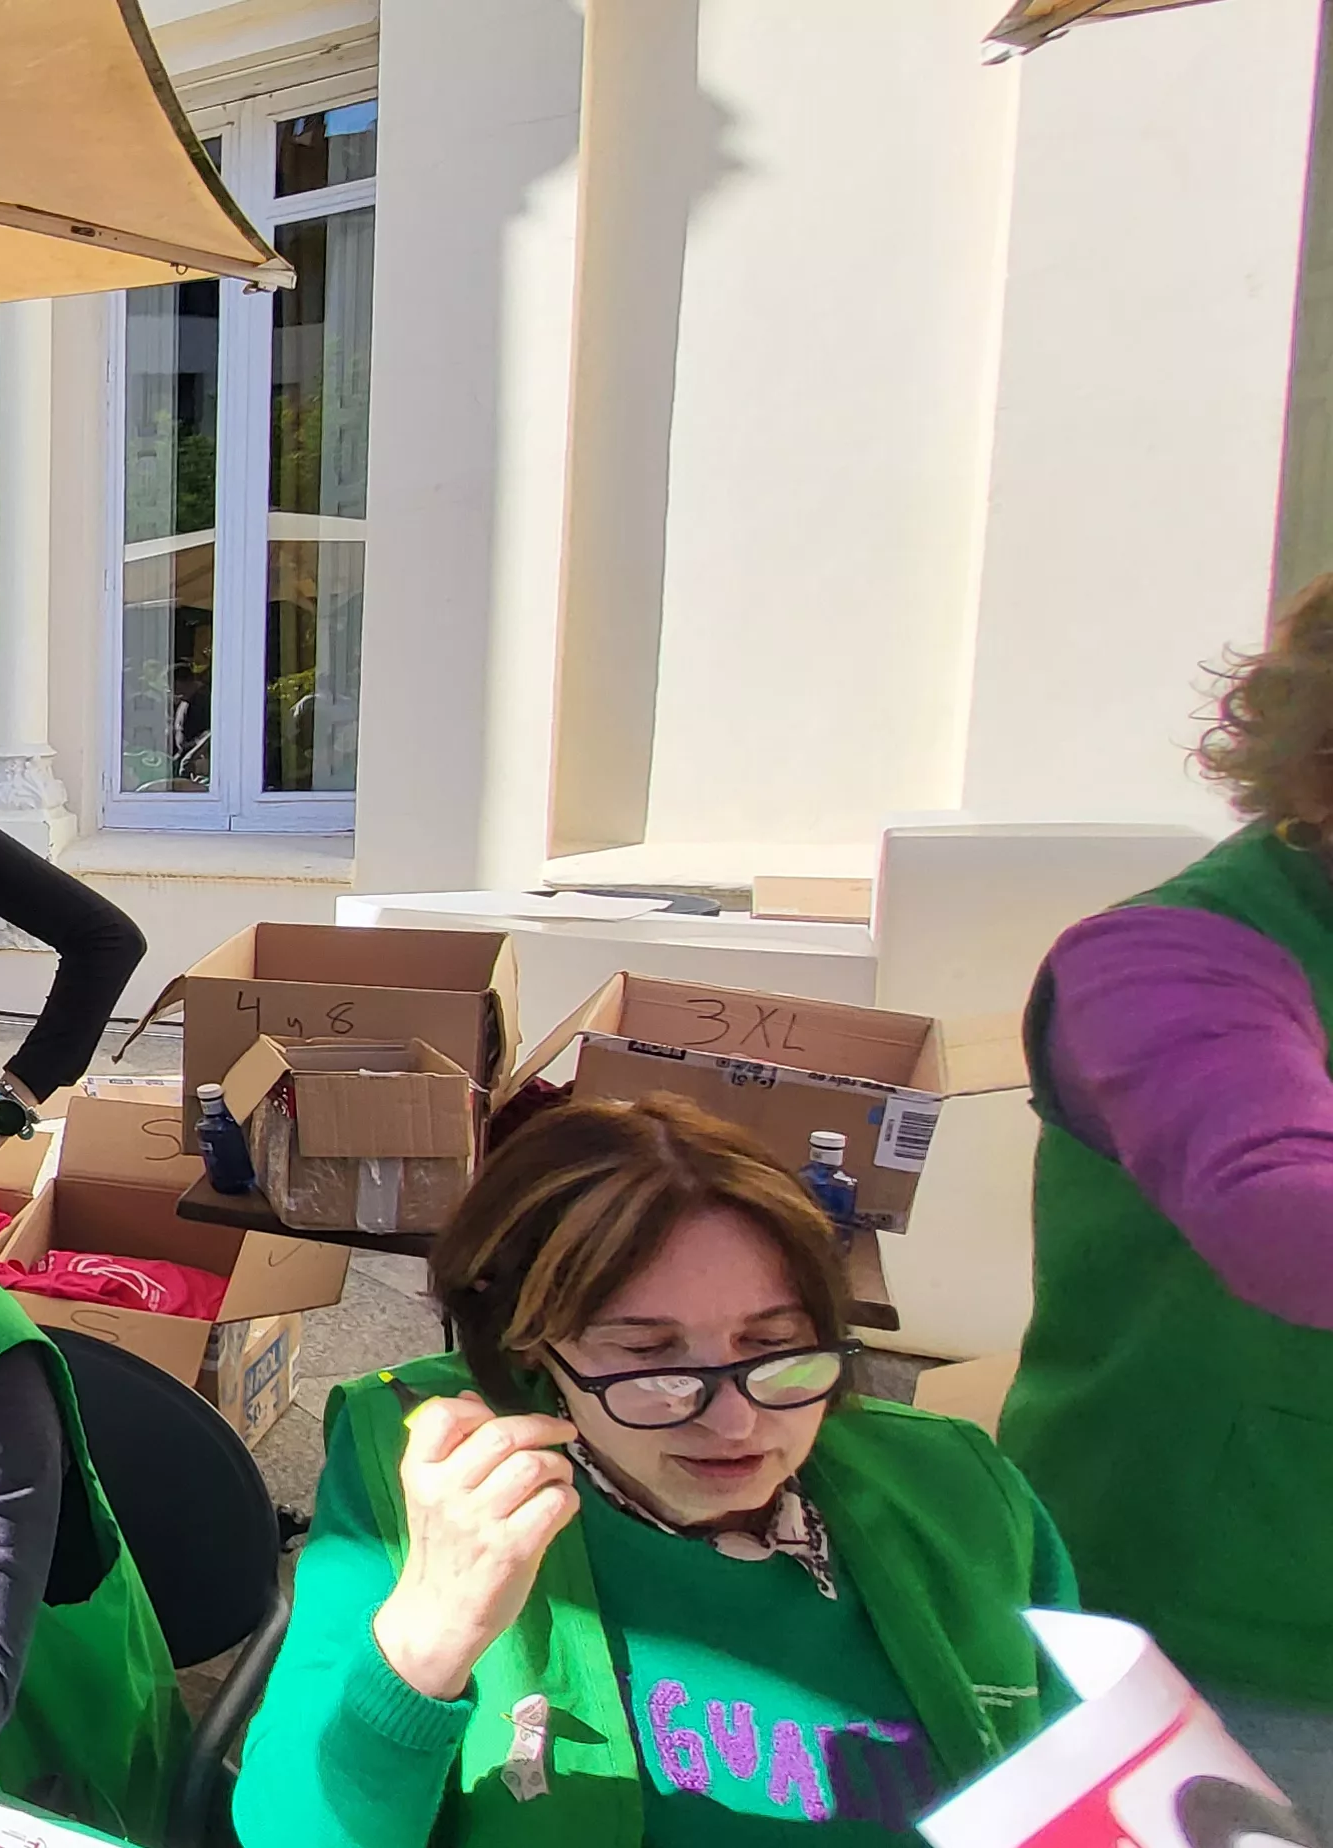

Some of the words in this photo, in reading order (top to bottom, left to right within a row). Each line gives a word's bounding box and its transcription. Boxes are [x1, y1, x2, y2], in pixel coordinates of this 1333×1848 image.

[237, 991, 260, 1033] 4
[326, 1002, 355, 1034] 8
[142, 1118, 183, 1160] S
[71, 1309, 121, 1343] S
